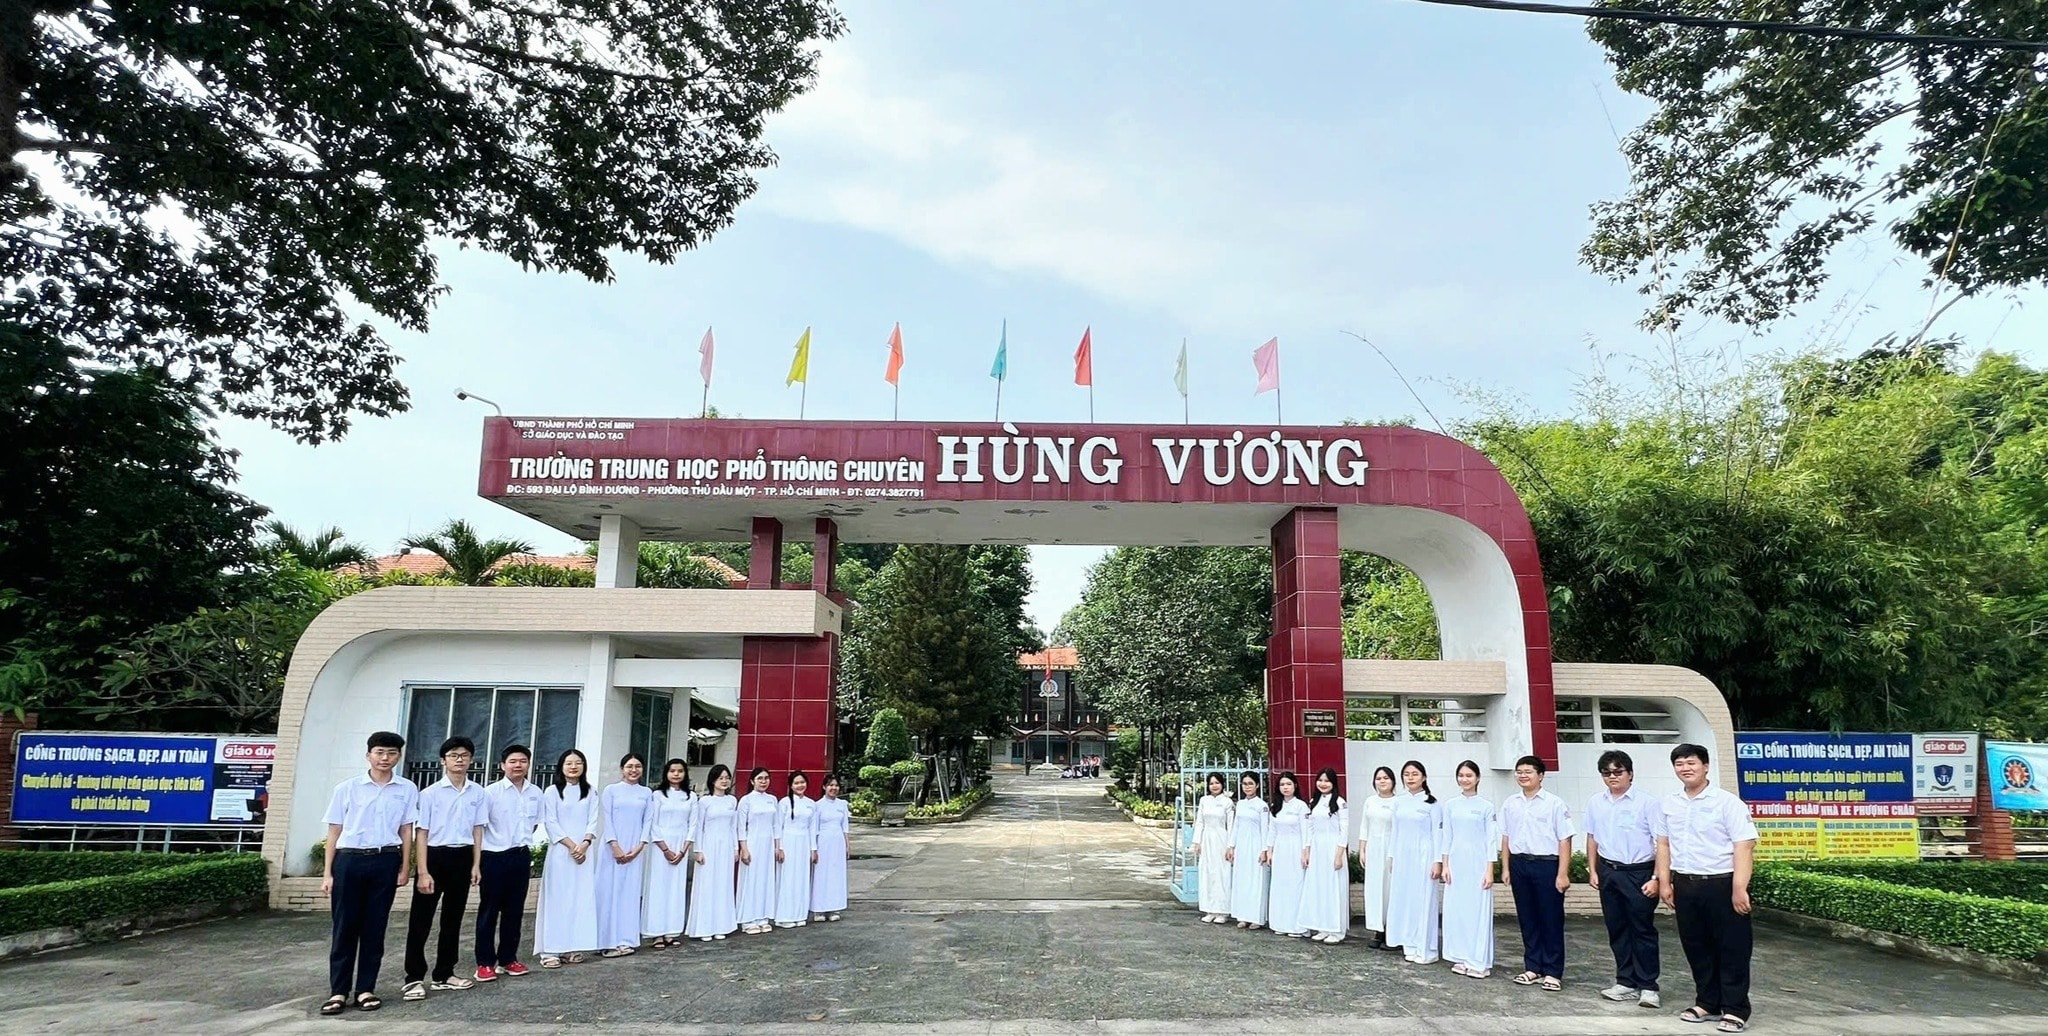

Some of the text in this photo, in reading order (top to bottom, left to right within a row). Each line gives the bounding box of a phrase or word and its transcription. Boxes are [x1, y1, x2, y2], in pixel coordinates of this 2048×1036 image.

[512, 418, 635, 430] UBND THÀNH PHỐ HỒ CHÍ MINH
[522, 428, 624, 441] SỞ GIÁO DỤC VÀ ĐÀO TẠO
[936, 422, 1369, 487] HÙNG VƯƠNG
[509, 449, 924, 485] TRƯỜNG TRUNG HỌC PHỔ THÔNG CHUYÊN
[506, 484, 525, 494] ĐC:
[526, 484, 544, 494] 593
[545, 484, 562, 496] ĐẠI
[563, 484, 578, 496] LỘ
[578, 484, 603, 494] BÌNH
[604, 485, 640, 495] DƯƠNG
[648, 484, 689, 495] PHƯỜNG
[691, 484, 711, 496] THỦ
[713, 484, 734, 496] DẦU
[736, 486, 756, 498] MỘT
[764, 487, 778, 496] TP.
[780, 484, 794, 496] HỒ
[796, 486, 813, 496] CHÍ
[815, 487, 840, 496] MINH
[847, 488, 863, 496] ĐT:
[25, 744, 208, 765] CỔNG TRƯỜNG SẠCH, ĐẸP, AN TOÀN
[225, 745, 253, 757] giáo
[1764, 741, 1910, 761] CỔNG TRƯỜNG SẠCH, ĐẸP, AN TOÀN
[22, 772, 50, 789] Chuyển
[1756, 803, 1792, 816] PHƯỢNG
[1795, 803, 1819, 815] CHÂU
[1820, 804, 1915, 817] NHÀ XE PHƯỢNG CHÂU
